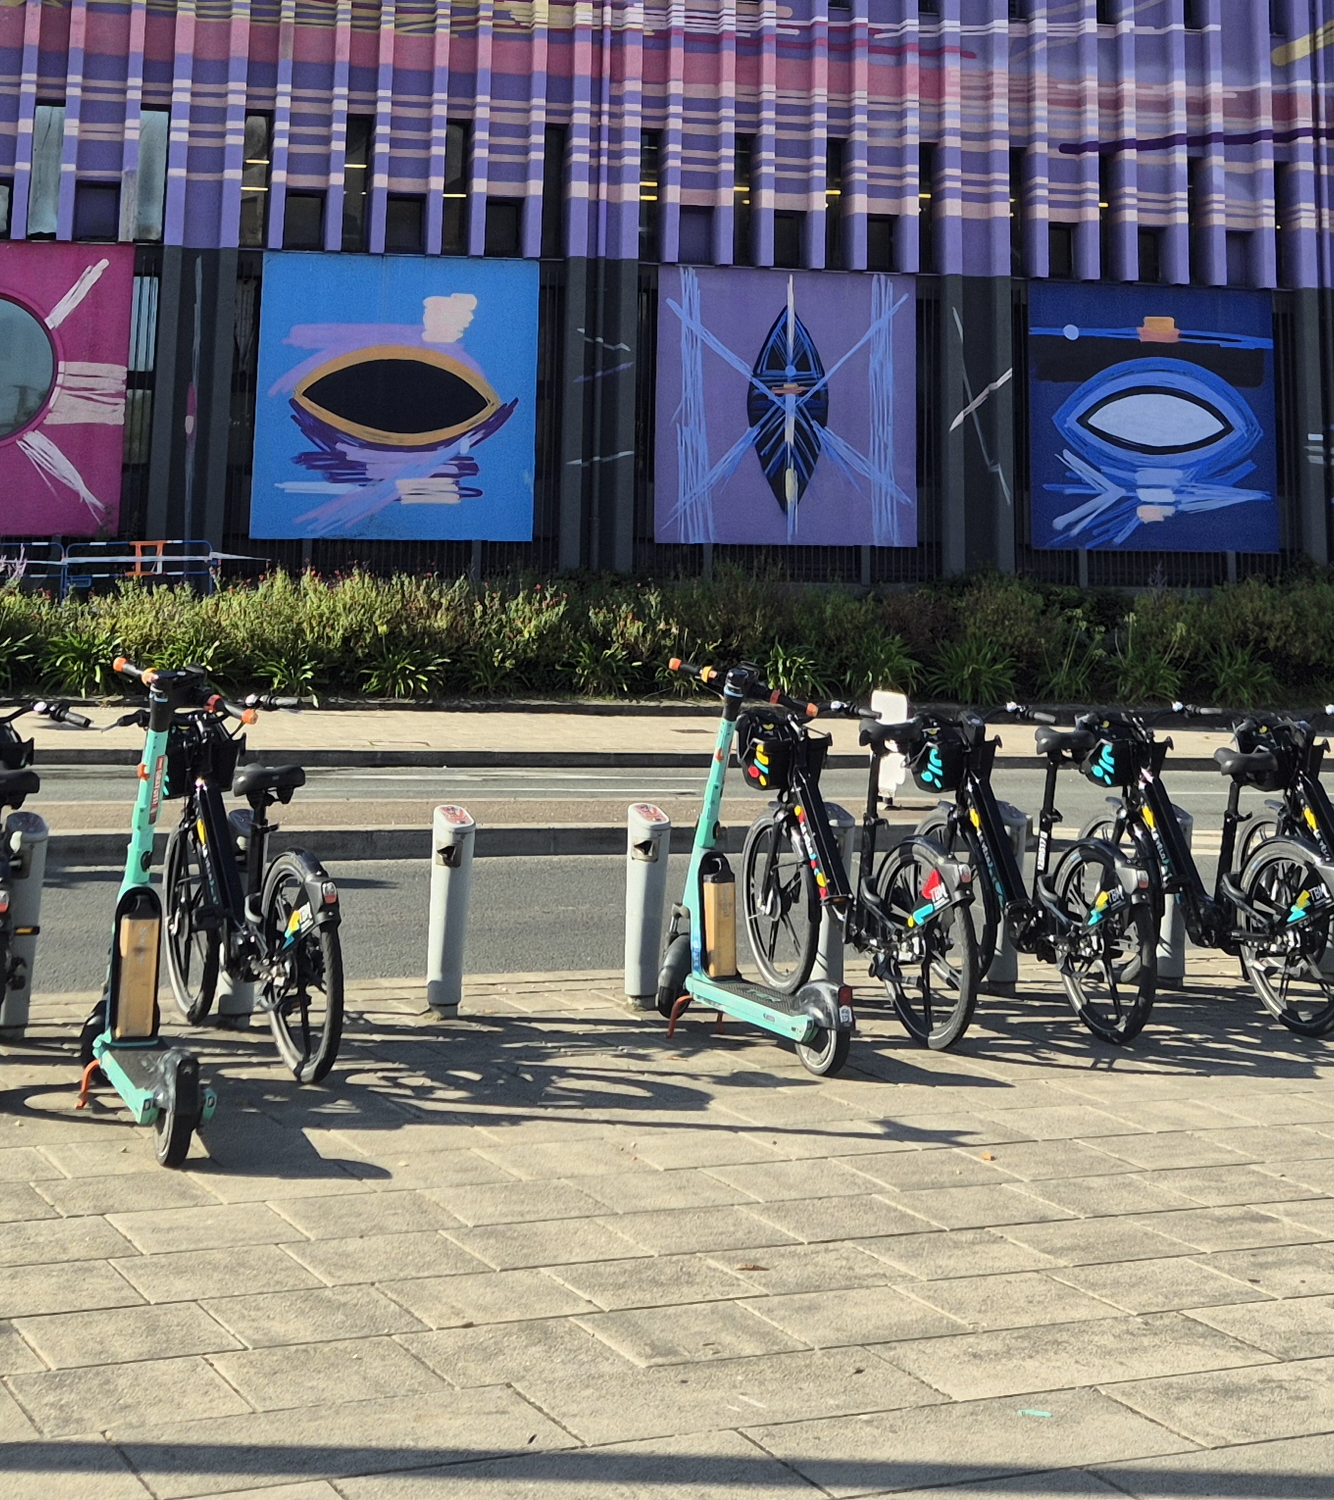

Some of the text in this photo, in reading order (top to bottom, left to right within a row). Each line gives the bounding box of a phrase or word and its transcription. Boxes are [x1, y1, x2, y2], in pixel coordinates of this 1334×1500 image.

[928, 882, 949, 902] TBM
[1107, 885, 1124, 902] TBM
[1308, 883, 1330, 901] TBM
